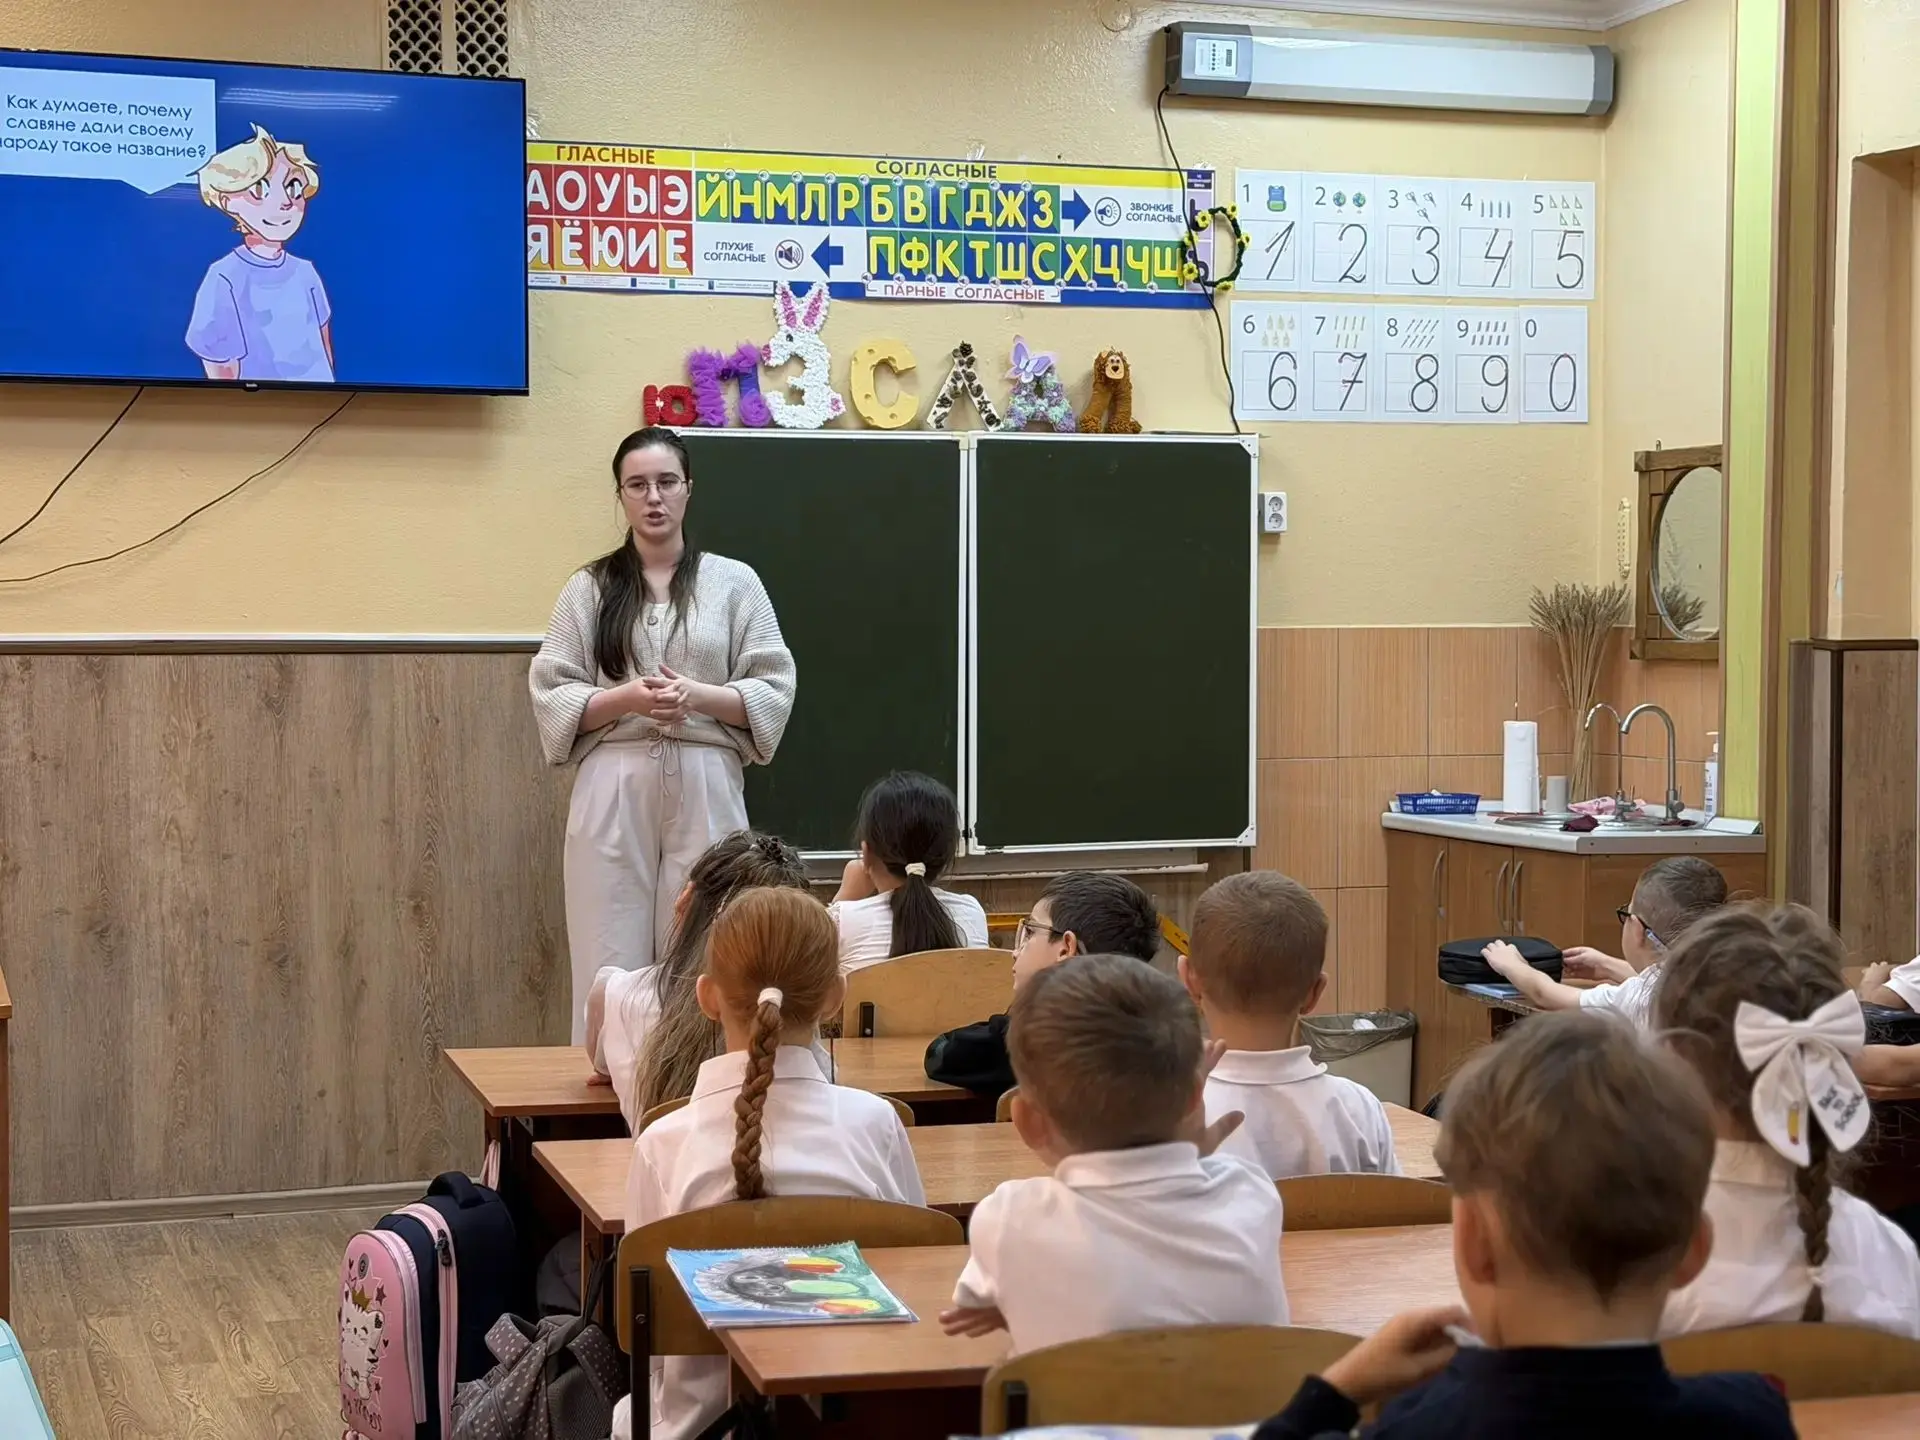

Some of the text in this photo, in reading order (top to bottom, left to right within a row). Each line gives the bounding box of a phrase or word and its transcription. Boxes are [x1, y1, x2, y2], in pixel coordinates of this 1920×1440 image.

[6, 94, 192, 121] Как думаете, почему
[6, 117, 194, 141] славяне дали своему
[63, 140, 112, 154] такое
[117, 143, 206, 158] название?
[556, 145, 656, 165] ГЛАСНЫЕ
[875, 160, 998, 179] СОГЛАСНЫЕ
[1129, 202, 1174, 213] ЗВОНКИЕ
[1242, 183, 1544, 214] 1 2 3 4 5
[1125, 212, 1183, 224] СОГЛАСНЫЕ
[715, 240, 754, 252] ГЛУХИЕ
[1265, 221, 1584, 288] 1 2 3 4 5
[703, 251, 767, 264] СОГЛАСНЫЕ
[884, 284, 1046, 301] ПАРНЫЕ СОГЛАСНЫЕ
[1243, 315, 1537, 339] 6 7 8 9 0
[1268, 352, 1576, 413] 6 7 8 9 0
